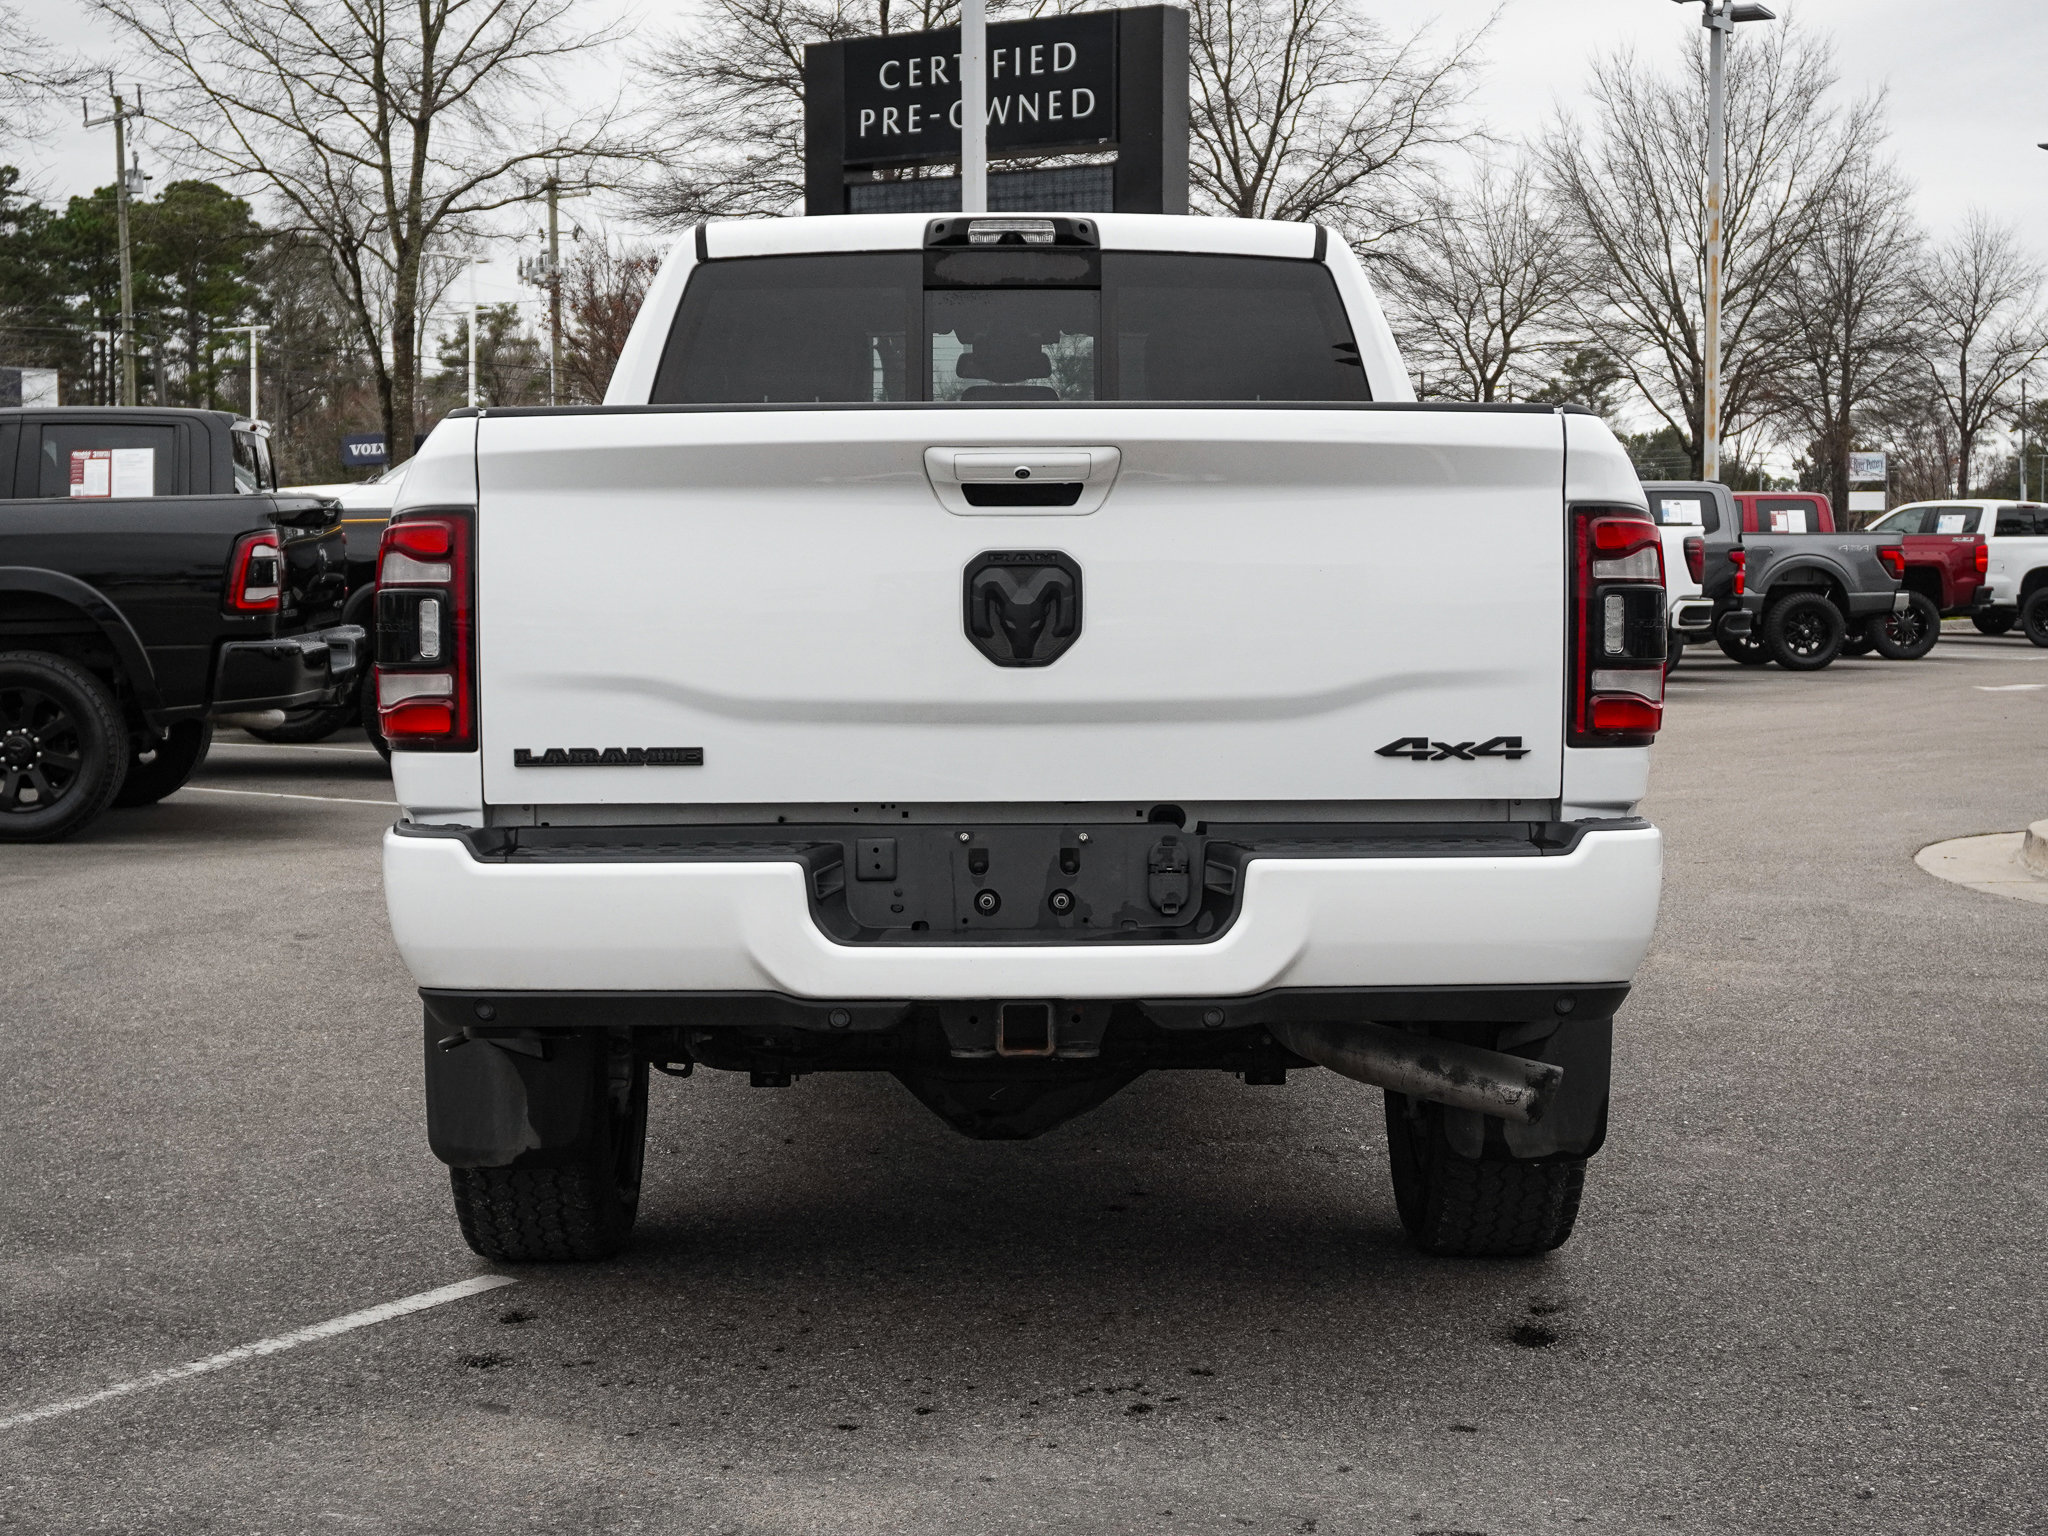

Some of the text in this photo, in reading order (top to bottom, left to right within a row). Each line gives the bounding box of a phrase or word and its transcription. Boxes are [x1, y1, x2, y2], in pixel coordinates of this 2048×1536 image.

[879, 42, 1077, 90] CERTFIED
[349, 443, 386, 456] VOL
[514, 747, 703, 767] LARAMIE
[1374, 736, 1532, 761] 4x4
